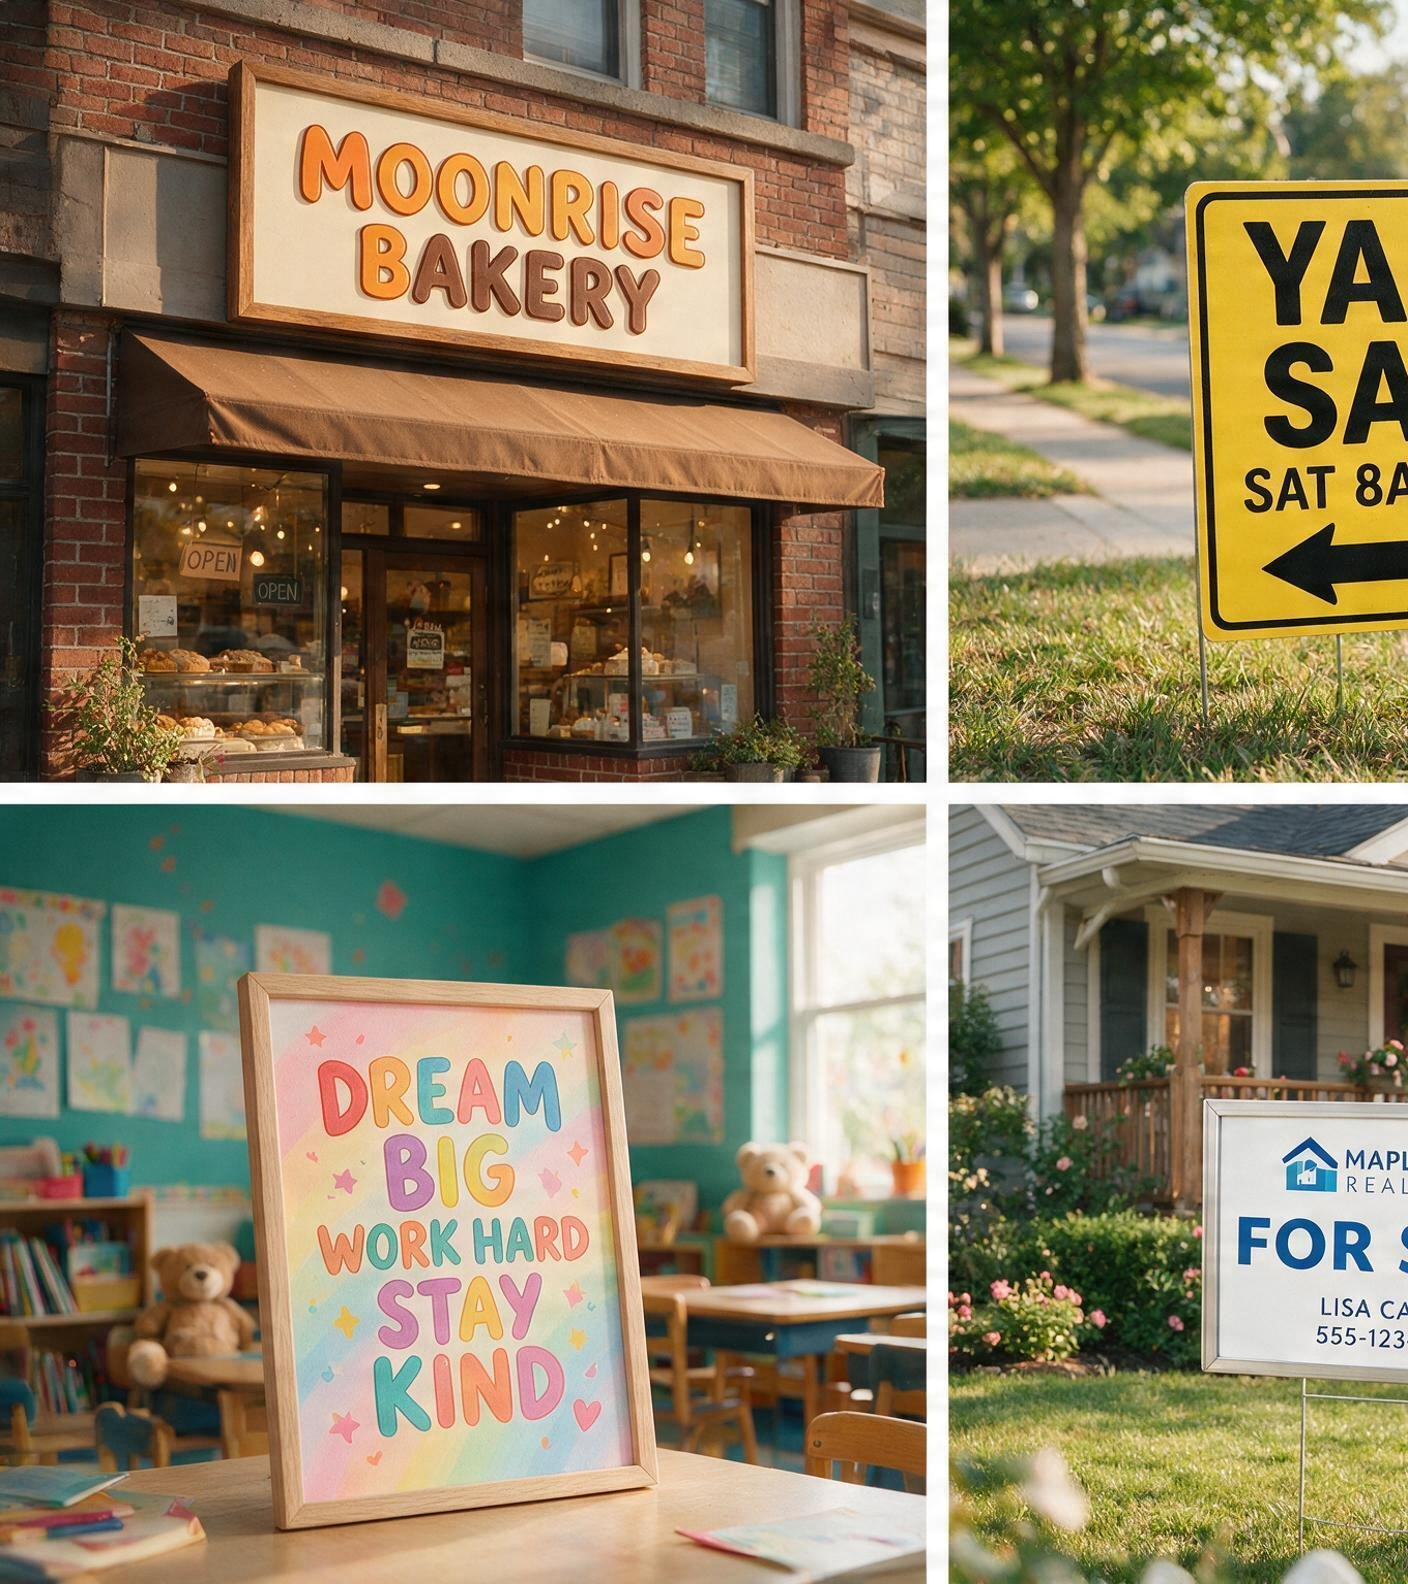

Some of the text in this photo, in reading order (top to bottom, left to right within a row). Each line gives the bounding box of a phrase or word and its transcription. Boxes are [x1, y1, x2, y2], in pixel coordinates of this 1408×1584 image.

[300, 124, 706, 268] MOONRISE
[360, 223, 661, 335] BAKERY
[1244, 466, 1335, 513] SAT
[187, 550, 237, 573] OPEN
[258, 581, 298, 601] OPEN
[317, 1056, 562, 1136] DREAM
[383, 1133, 515, 1212] BIG
[317, 1215, 590, 1275] WORK HARD
[1237, 1216, 1375, 1272] FOR
[377, 1273, 543, 1350] STAY
[1321, 1297, 1371, 1318] LISA
[373, 1346, 564, 1437] KIND
